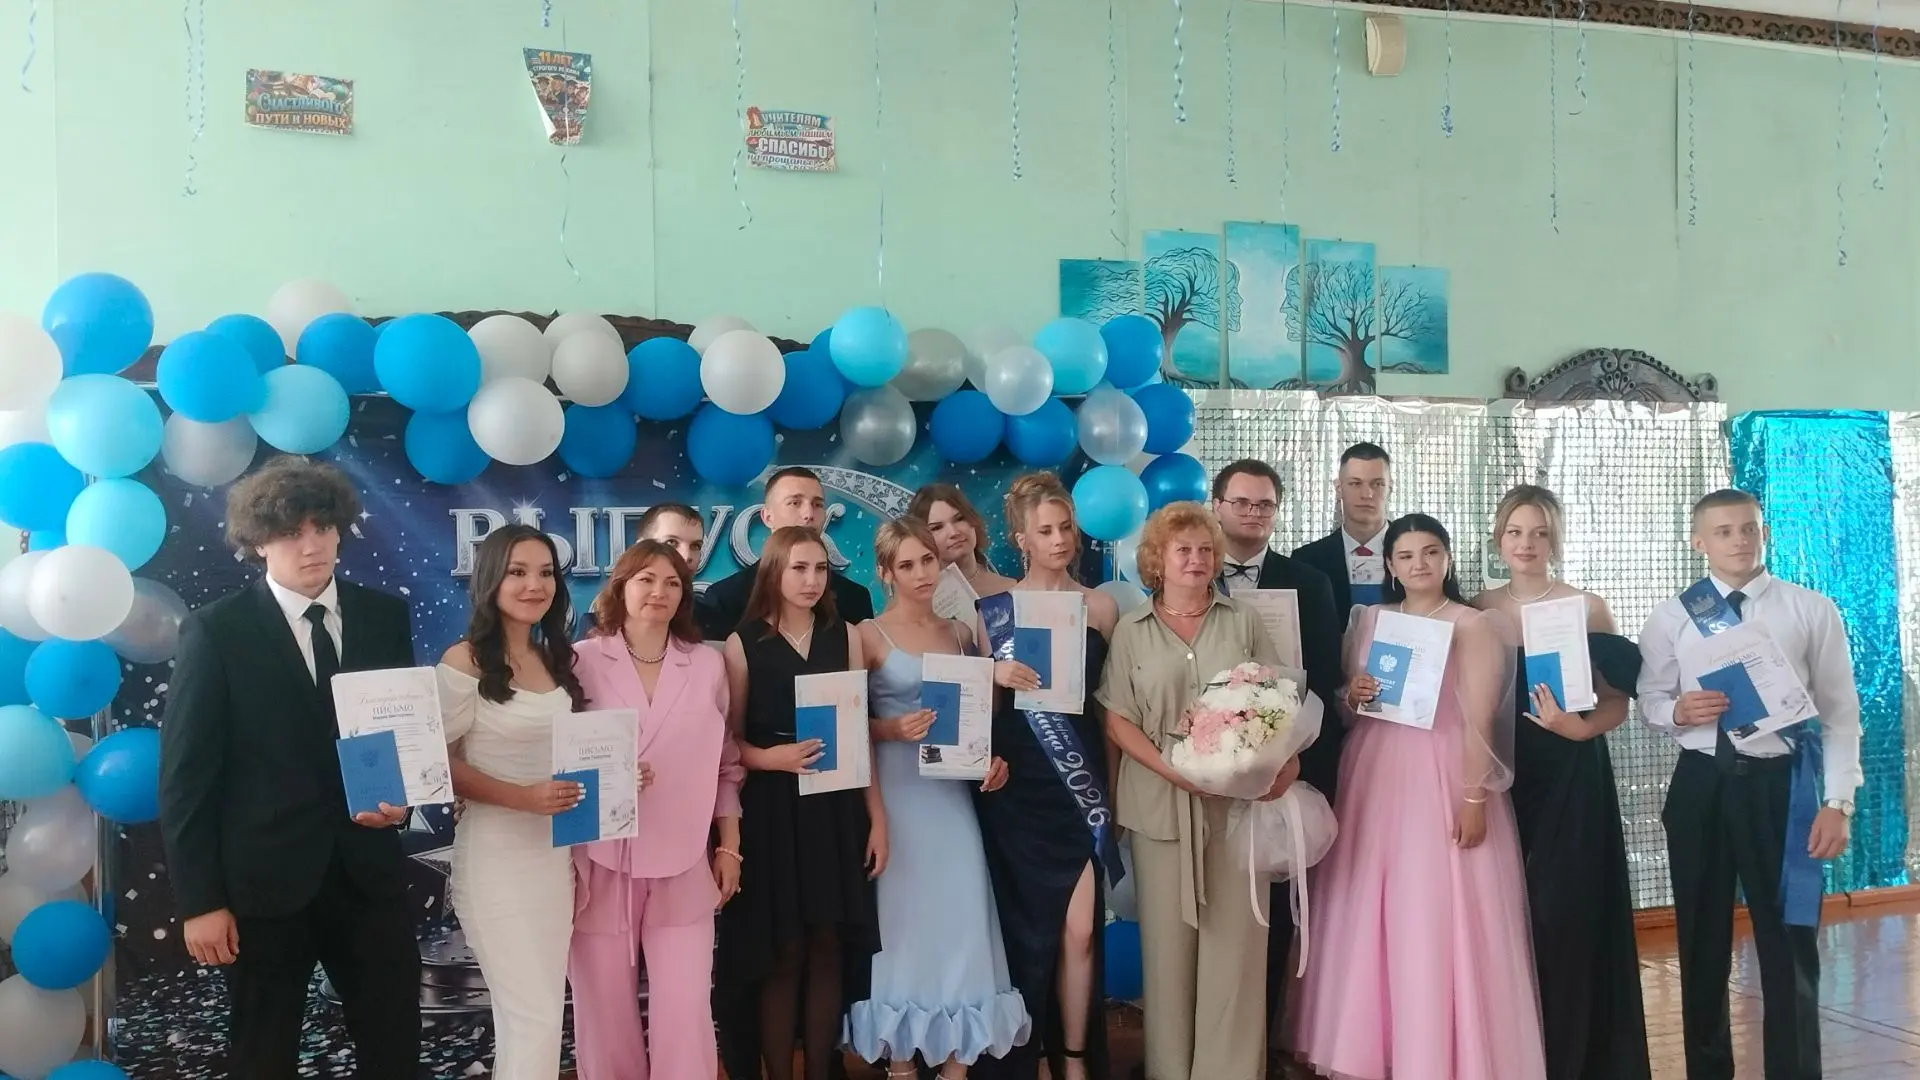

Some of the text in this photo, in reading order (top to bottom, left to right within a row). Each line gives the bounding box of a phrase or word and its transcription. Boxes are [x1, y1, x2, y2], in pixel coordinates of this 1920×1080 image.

[255, 113, 289, 124] ПУТИ
[303, 114, 346, 128] НОВЫХ
[762, 112, 821, 128] УЧИТЕЛЯМ
[758, 138, 828, 159] СПАСИБО
[1052, 751, 1111, 827] 2026
